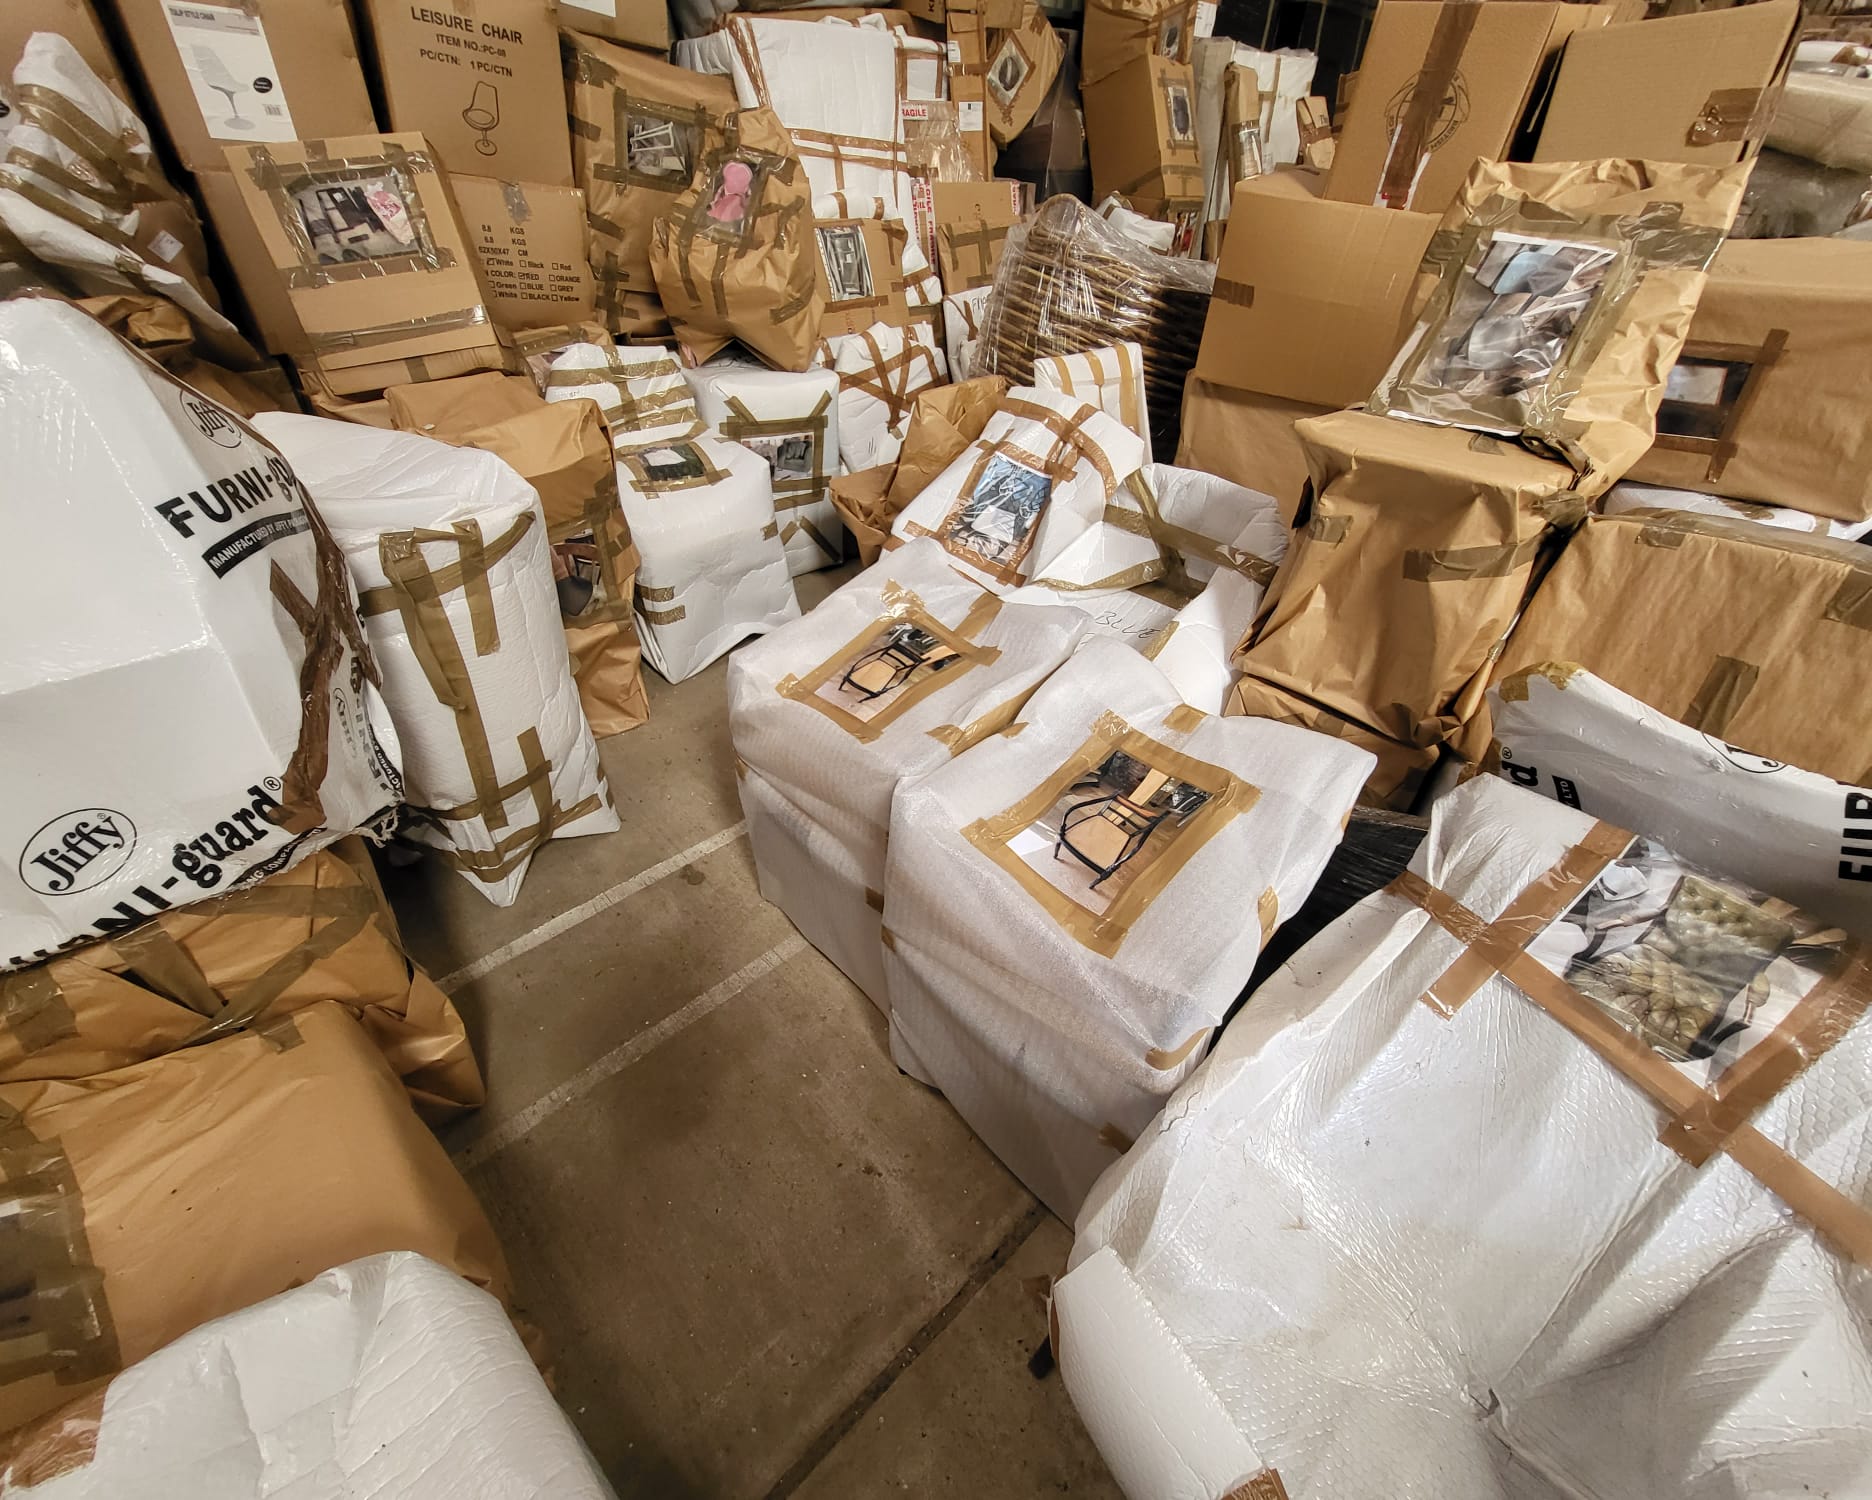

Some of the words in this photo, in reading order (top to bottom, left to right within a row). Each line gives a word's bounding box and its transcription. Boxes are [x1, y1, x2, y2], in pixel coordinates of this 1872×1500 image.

[411, 6, 474, 32] LEISURE
[481, 23, 523, 45] CHAIR
[436, 33, 461, 48] ITEM
[902, 109, 927, 118] RAGILE
[555, 275, 581, 283] ORANGE
[527, 282, 544, 291] BLUE
[557, 284, 574, 292] GREY
[528, 293, 551, 301] BLACK
[209, 529, 269, 569] MANUFACTURED
